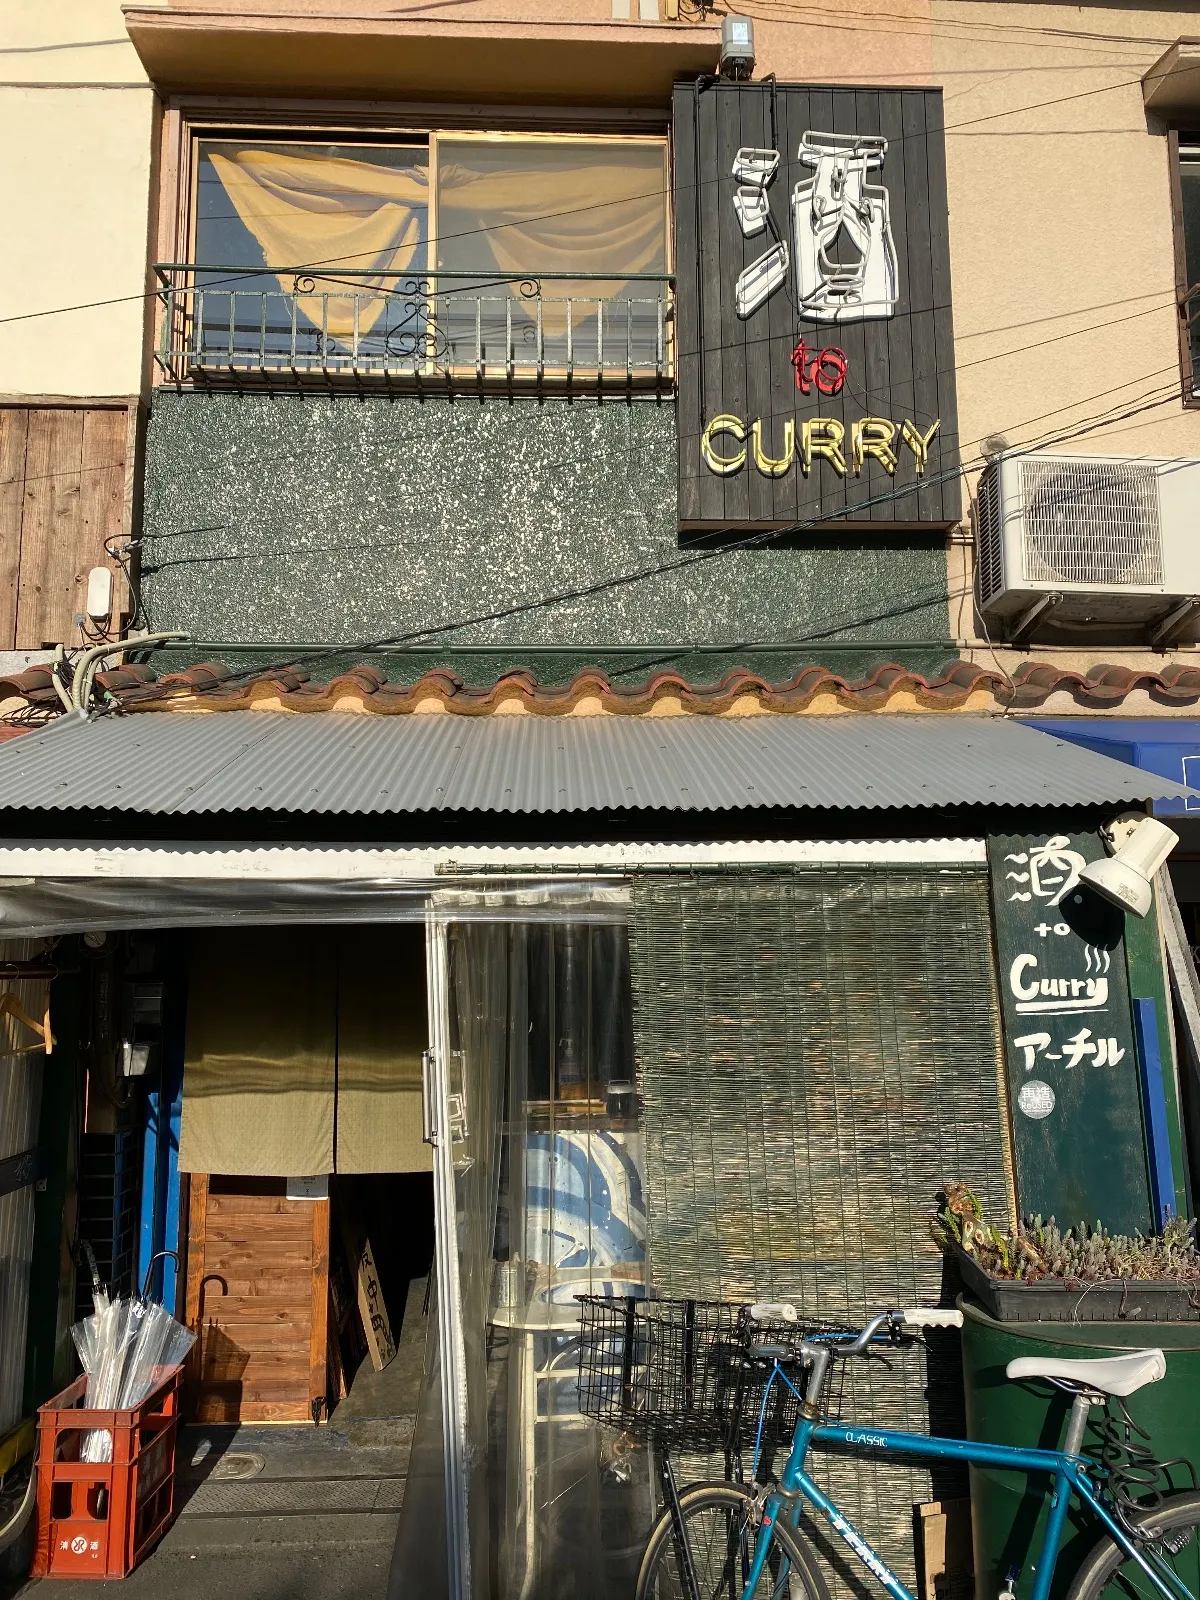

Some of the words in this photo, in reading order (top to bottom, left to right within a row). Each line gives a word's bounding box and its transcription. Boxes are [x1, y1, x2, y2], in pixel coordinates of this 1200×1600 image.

[732, 130, 899, 324] 酒
[791, 338, 848, 394] to
[702, 413, 941, 478] CURRY
[1004, 835, 1087, 906] 酒
[1034, 922, 1071, 937] to
[1010, 953, 1109, 1006] Curry
[1014, 1027, 1125, 1070] アーチル
[845, 1431, 888, 1447] CLASSIC
